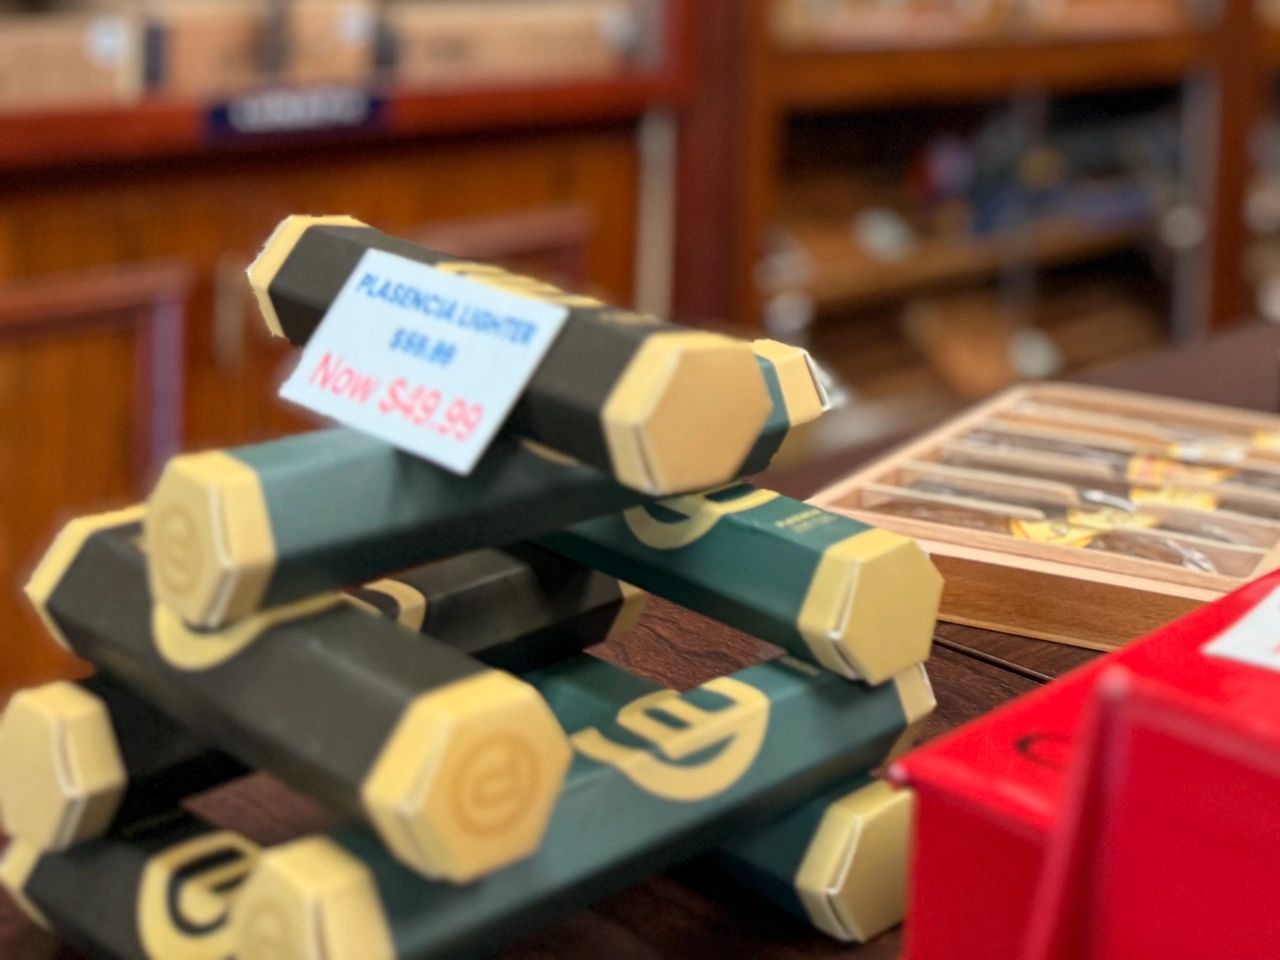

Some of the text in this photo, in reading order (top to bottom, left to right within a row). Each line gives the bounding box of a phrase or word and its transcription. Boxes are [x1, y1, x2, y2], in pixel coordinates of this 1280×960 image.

[358, 273, 537, 344] PLASENCIA LIGHTER
[378, 378, 484, 441] $49.99
